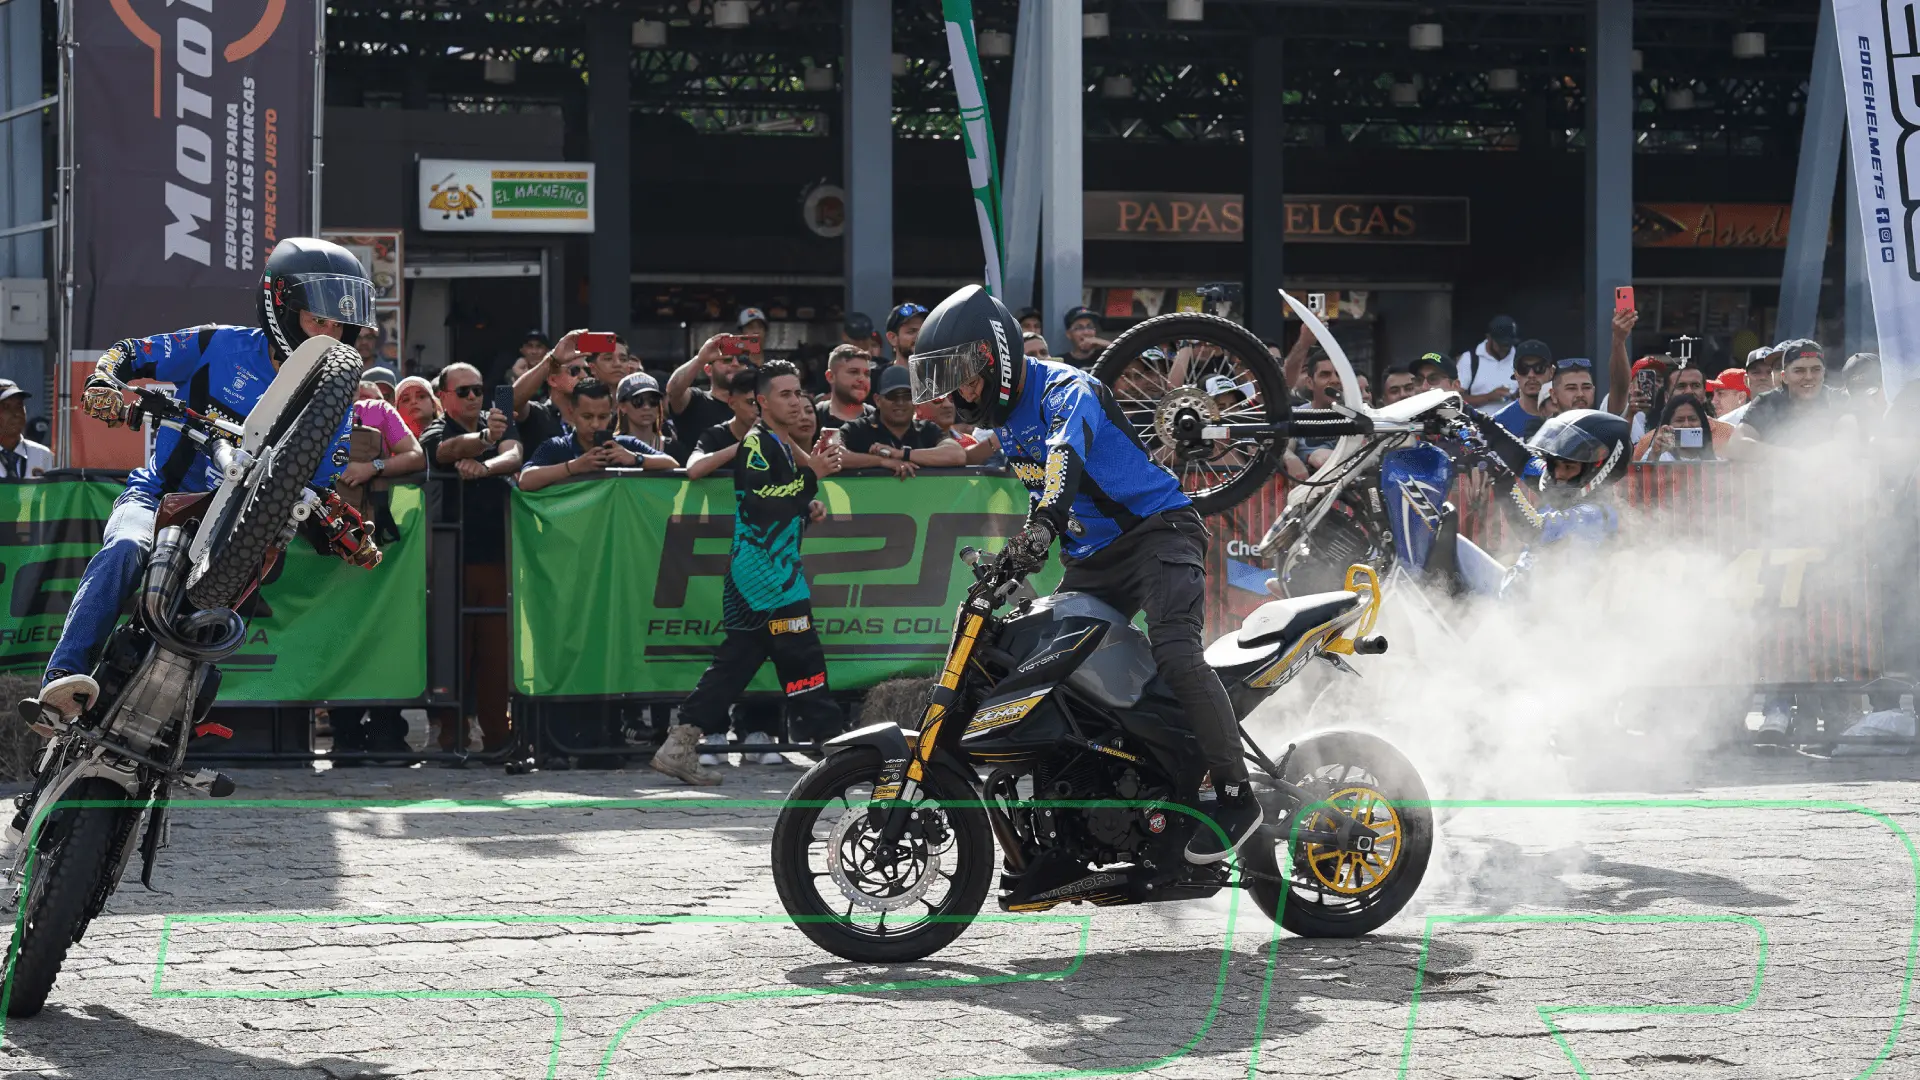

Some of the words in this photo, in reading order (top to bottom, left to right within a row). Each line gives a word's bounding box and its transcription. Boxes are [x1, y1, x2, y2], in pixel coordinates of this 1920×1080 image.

[164, 0, 213, 267] MOTO
[226, 103, 239, 158] PARA
[243, 76, 256, 162] MARCAS
[1858, 35, 1886, 201] EDGEHELMETS
[265, 108, 278, 168] JUSTO
[242, 165, 255, 201] LAS
[495, 190, 510, 204] EL
[225, 160, 239, 270] REPUESTOS
[265, 169, 277, 242] PRECIO
[1117, 200, 1243, 234] PAPAS
[1283, 203, 1416, 236] ELGAS
[242, 208, 254, 270] TODAS
[1693, 204, 1788, 247] Asad
[1226, 539, 1262, 557] Che
[812, 618, 884, 636] EDAS
[786, 671, 825, 694] M45
[1018, 653, 1060, 673] VICTORY
[973, 704, 1031, 723] VENOM
[1040, 872, 1116, 899] VICTORY
